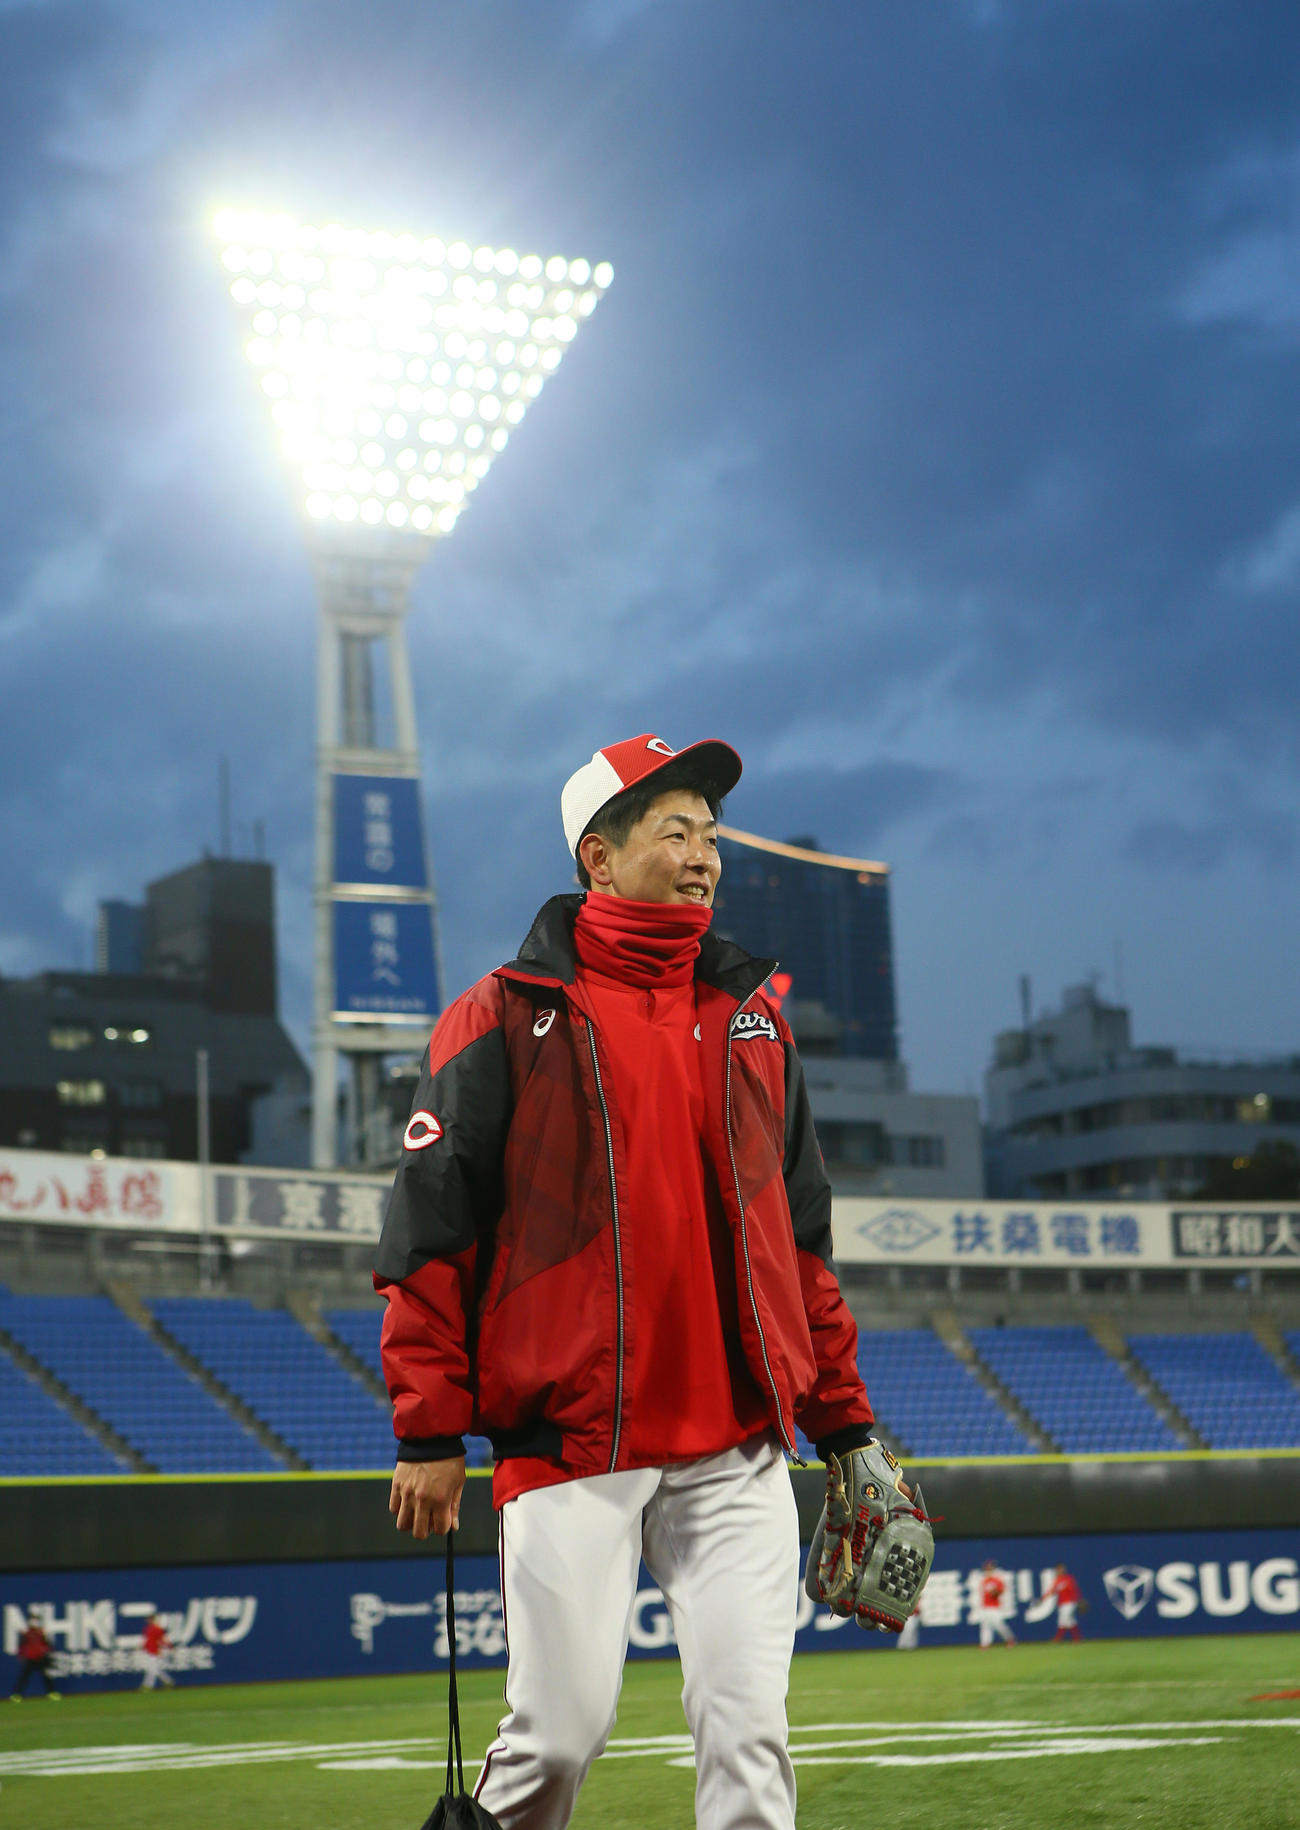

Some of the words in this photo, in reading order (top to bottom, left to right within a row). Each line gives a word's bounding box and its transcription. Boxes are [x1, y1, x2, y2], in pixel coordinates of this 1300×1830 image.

[951, 1211, 1141, 1257] 扶桑電機
[1155, 1557, 1300, 1619] SUG
